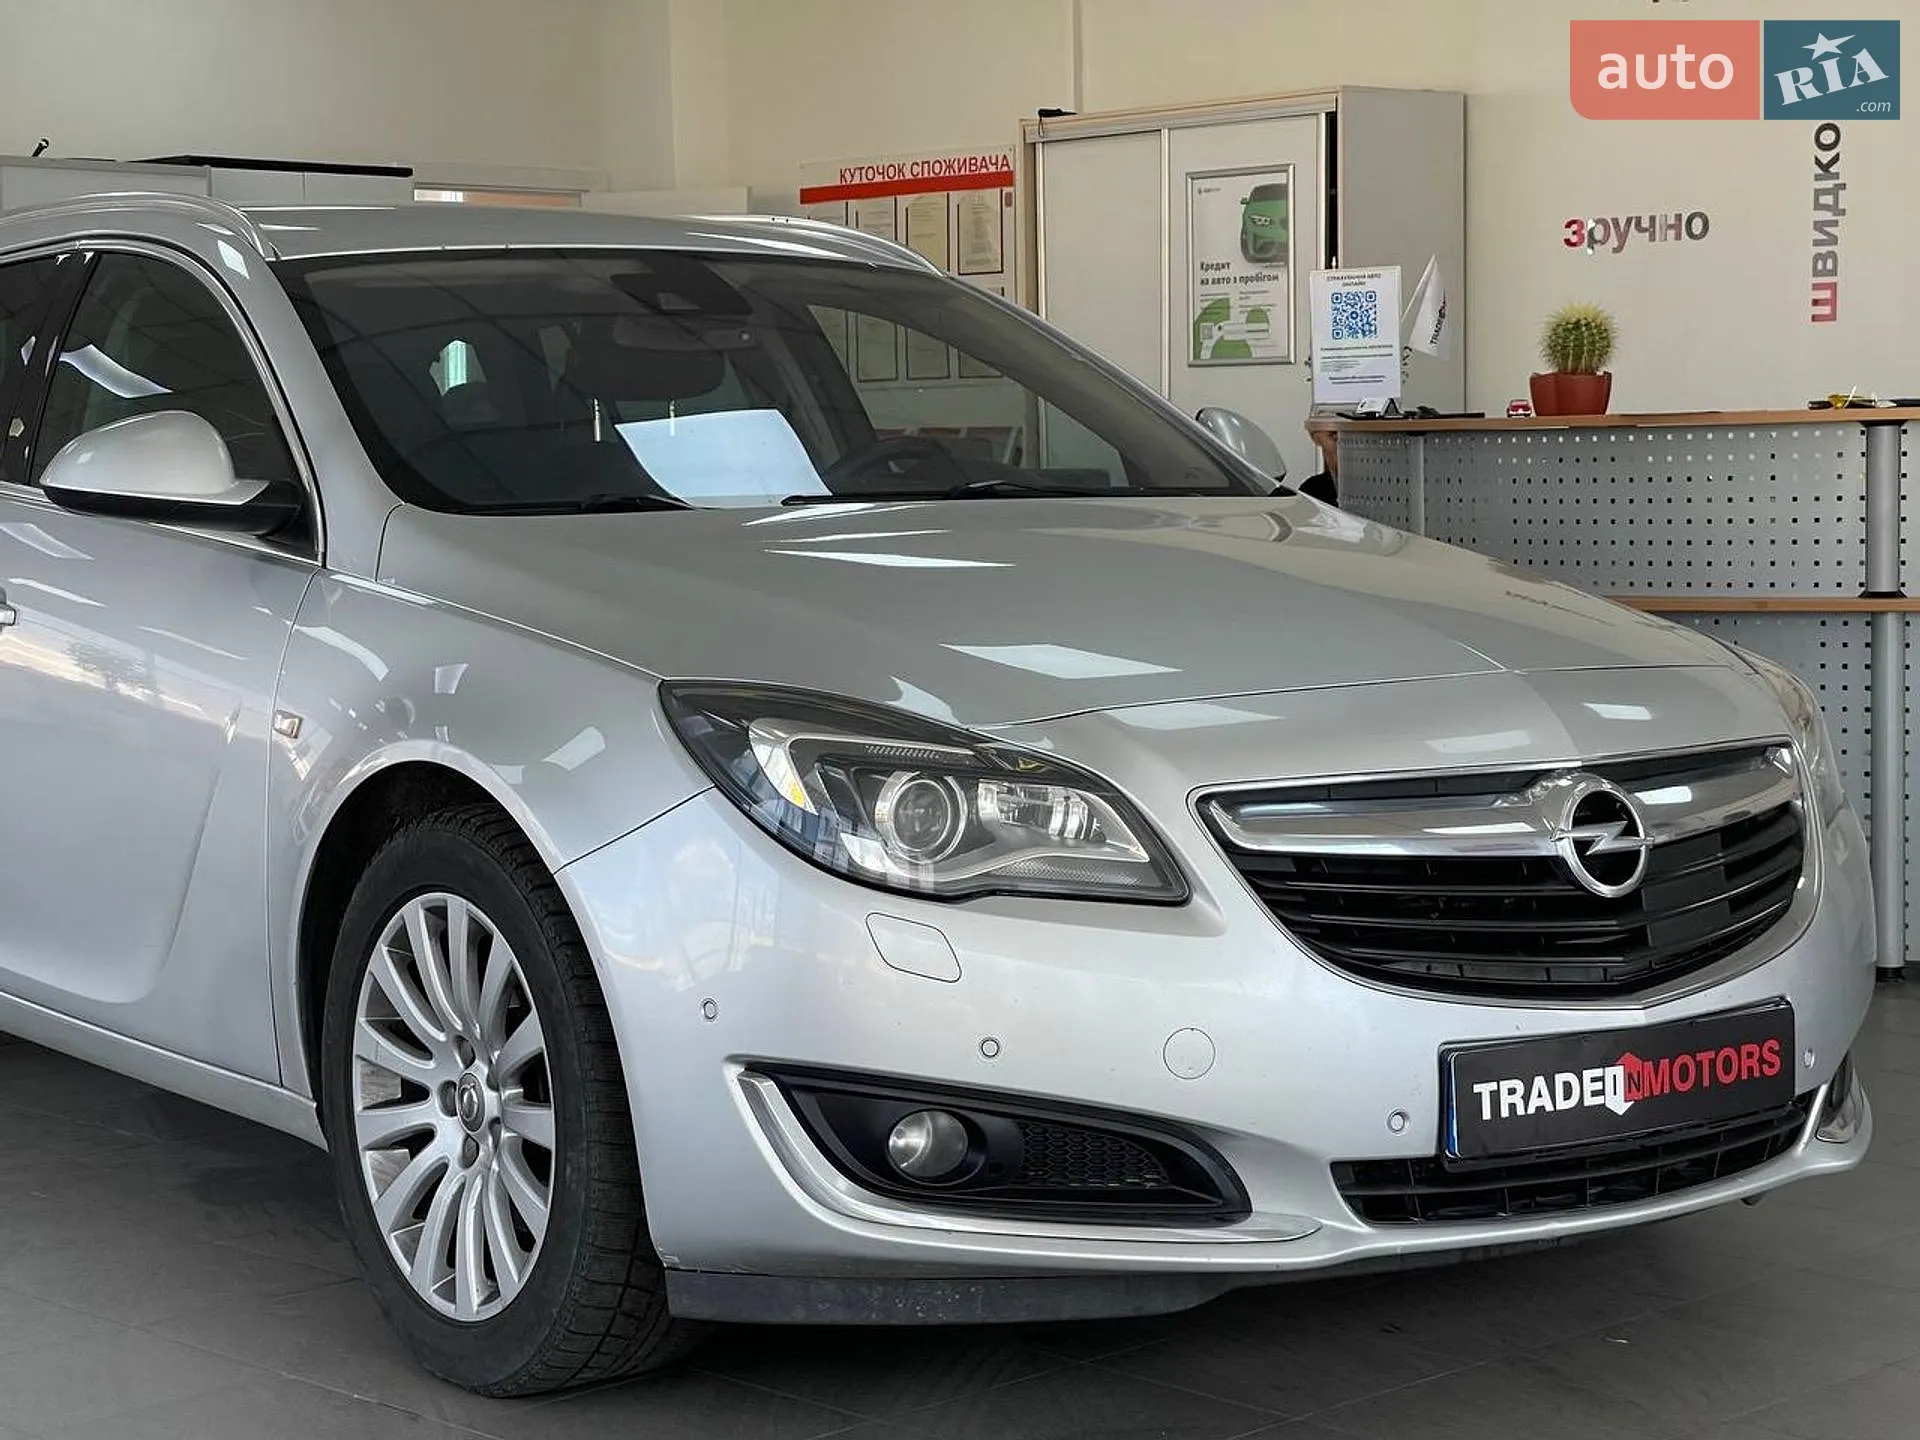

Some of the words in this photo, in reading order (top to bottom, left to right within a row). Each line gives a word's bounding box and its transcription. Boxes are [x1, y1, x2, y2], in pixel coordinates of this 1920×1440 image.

[839, 163, 906, 183] КУТОЧОК
[910, 154, 1011, 177] СПОЖИВАЧА
[1562, 211, 1710, 254] зручно
[1200, 261, 1231, 273] Кредит
[1211, 276, 1231, 285] авто
[1239, 271, 1280, 285] пробігом
